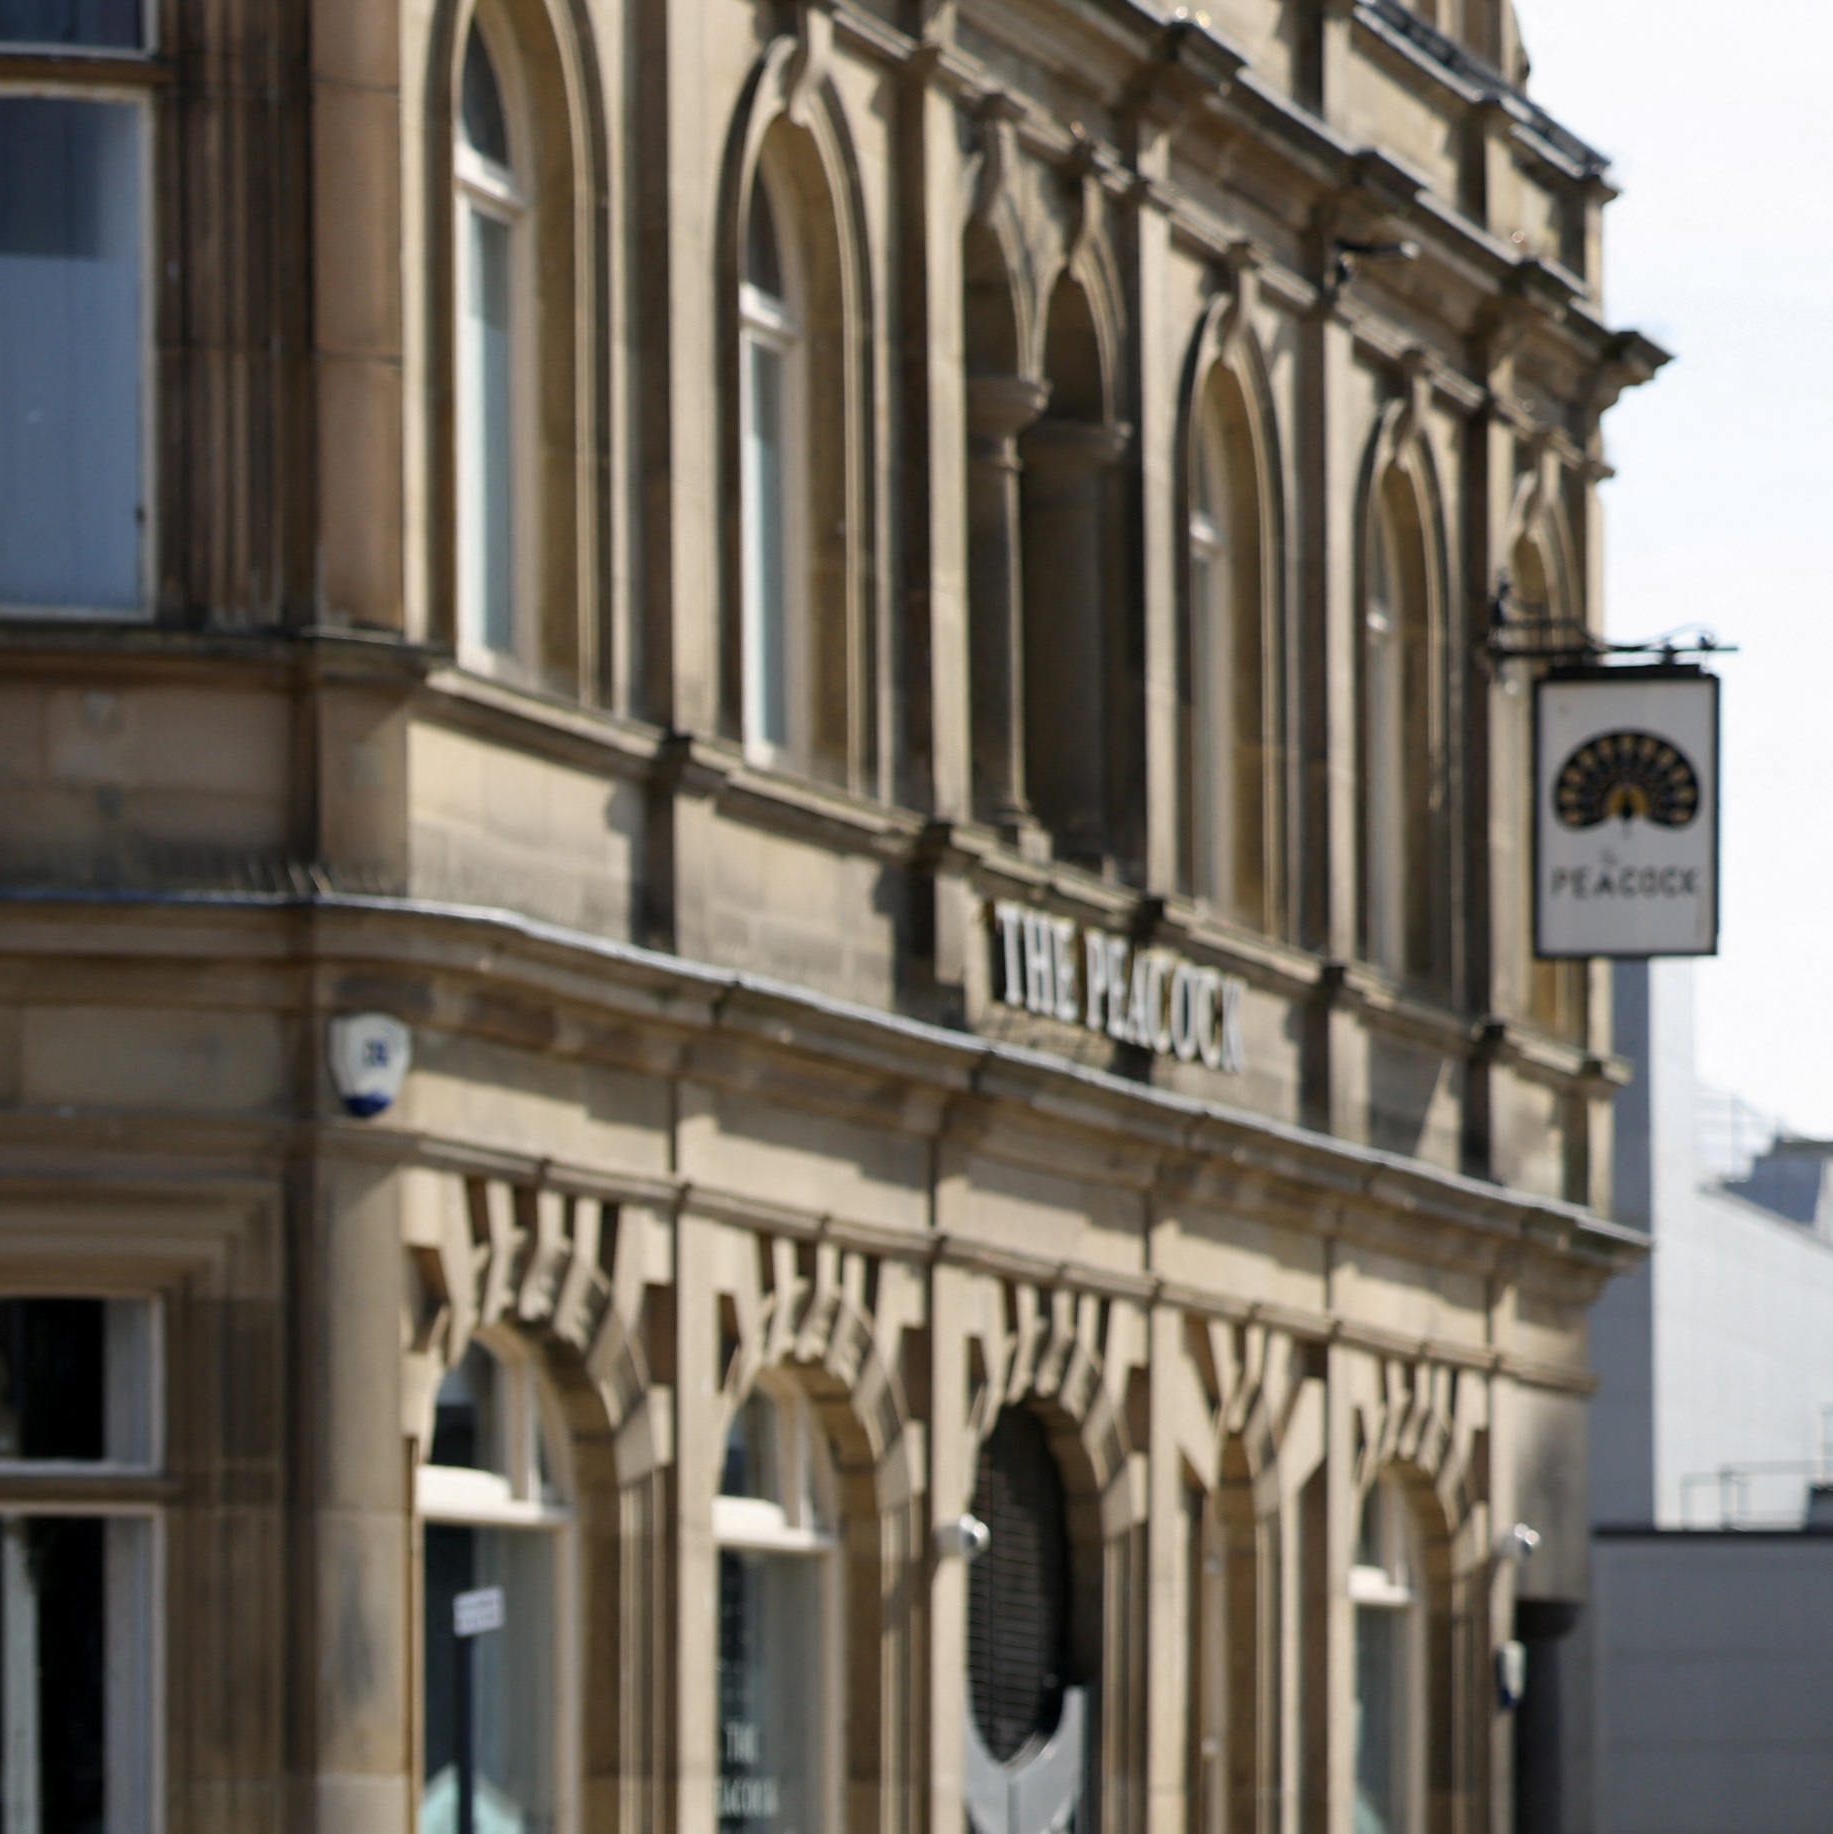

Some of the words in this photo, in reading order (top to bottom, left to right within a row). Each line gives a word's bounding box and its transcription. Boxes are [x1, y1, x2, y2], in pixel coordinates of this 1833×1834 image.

[1550, 866, 1698, 900] PEACOCK
[993, 899, 1078, 1022] THE
[1084, 927, 1245, 1072] PEACOCK
